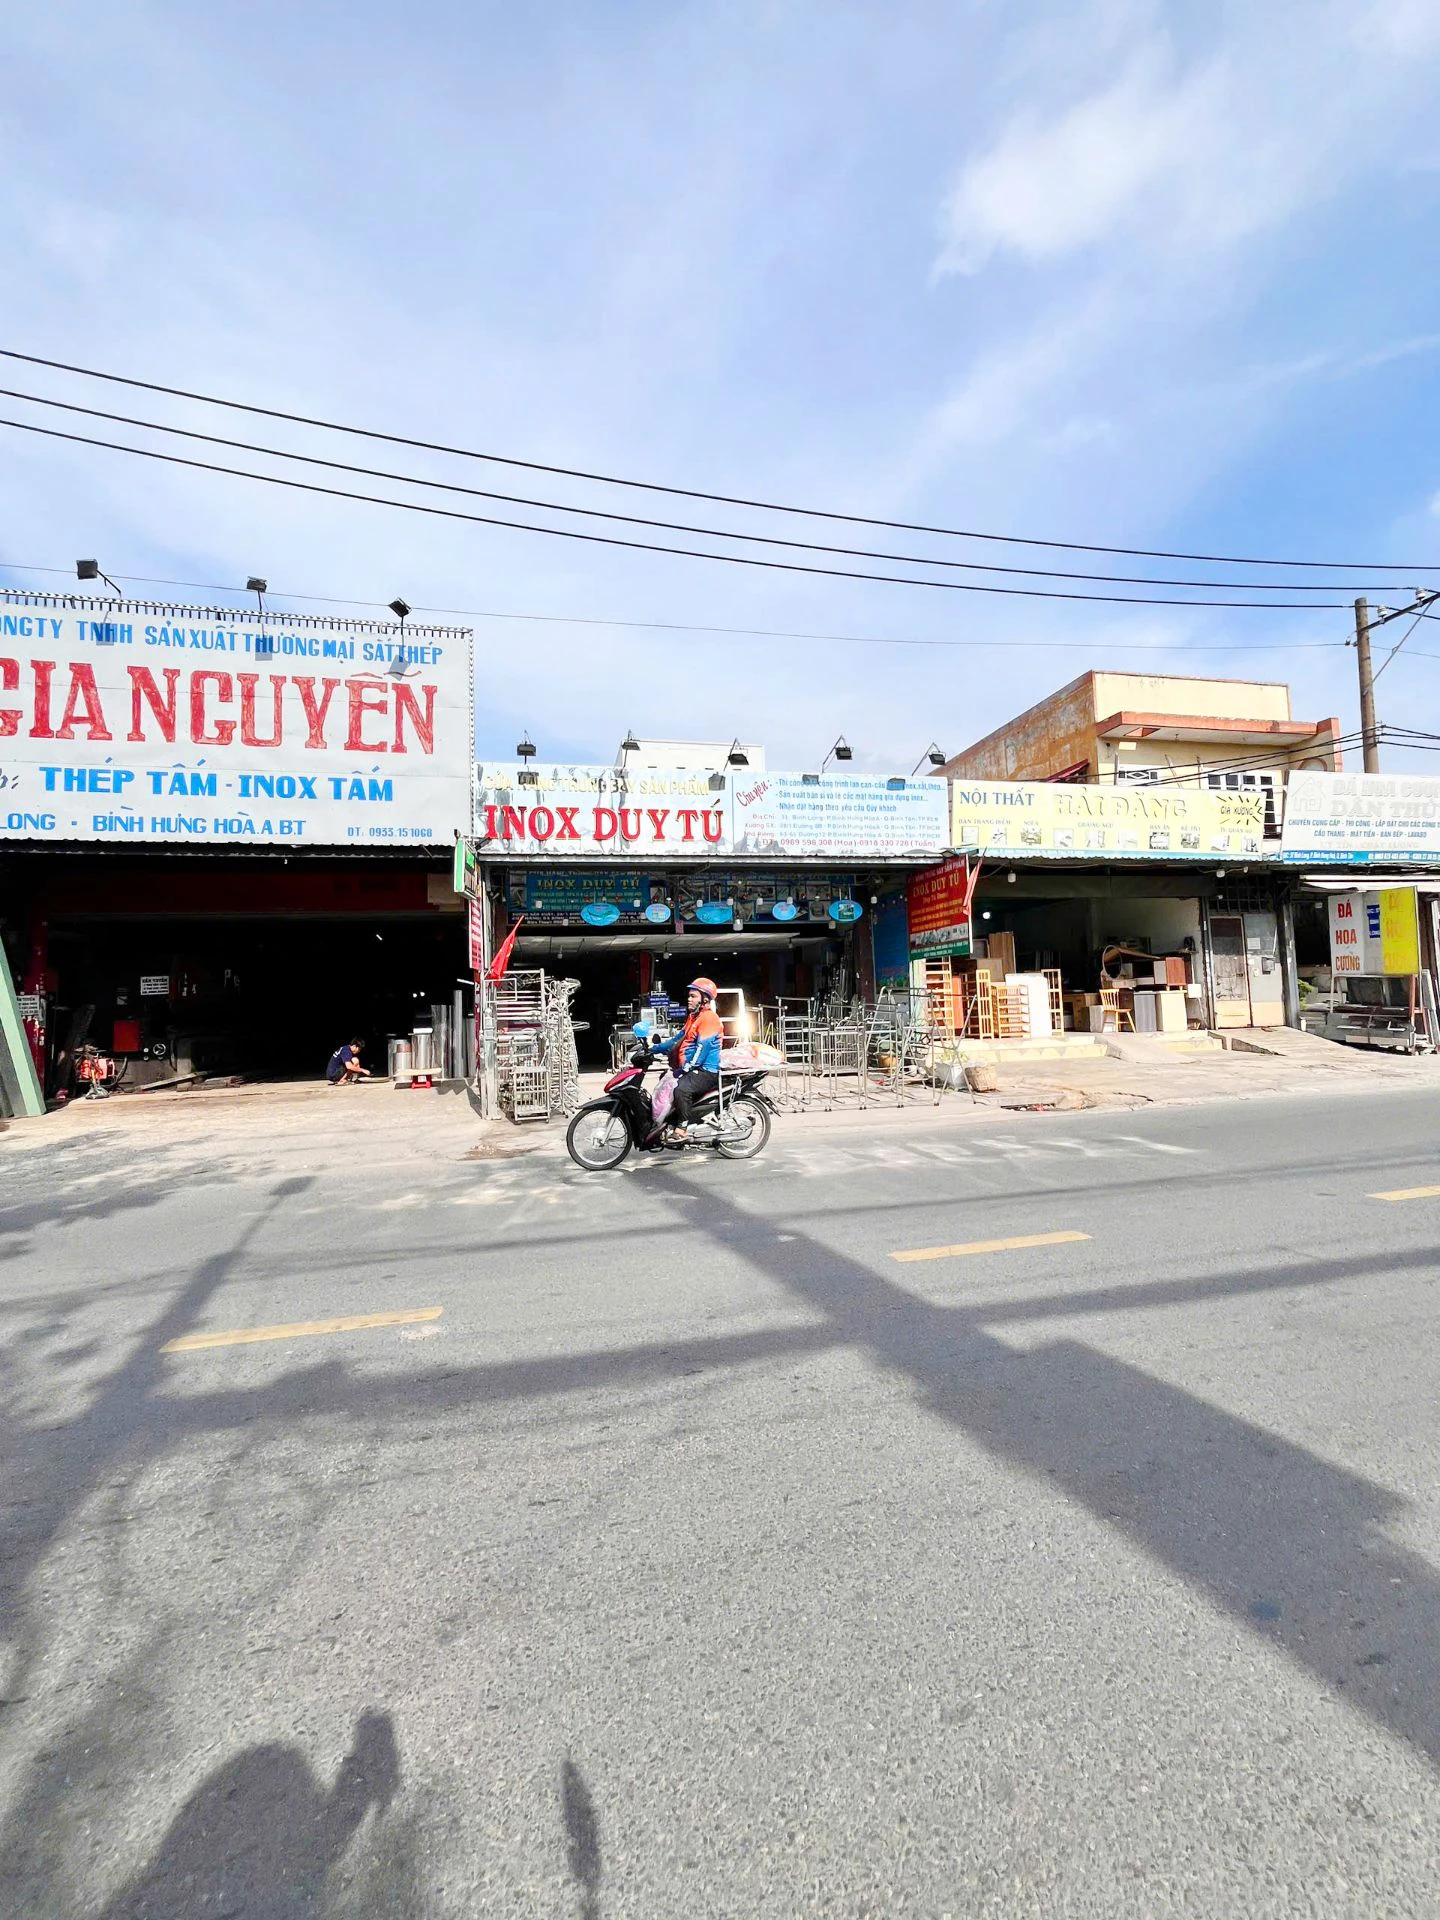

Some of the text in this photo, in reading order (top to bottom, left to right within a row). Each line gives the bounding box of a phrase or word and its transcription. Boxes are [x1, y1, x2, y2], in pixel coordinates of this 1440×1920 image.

[76, 620, 133, 644] TNHH
[145, 620, 186, 648] SẢN
[189, 624, 238, 651] XUẤT
[127, 666, 438, 754] NGUYỄN
[39, 756, 135, 794] THÉP
[146, 758, 217, 797] TẤM
[238, 774, 317, 800] INOX
[327, 765, 393, 802] TẤM
[959, 786, 1035, 807] NỘI THẤT
[93, 806, 144, 833] BÌNH
[151, 812, 207, 834] HƯNG
[483, 798, 724, 843] INOX DUY TÚ
[537, 878, 577, 890] INOX
[931, 877, 947, 892] DUY
[1337, 899, 1353, 918] ĐÁ
[1335, 928, 1358, 945] HOA
